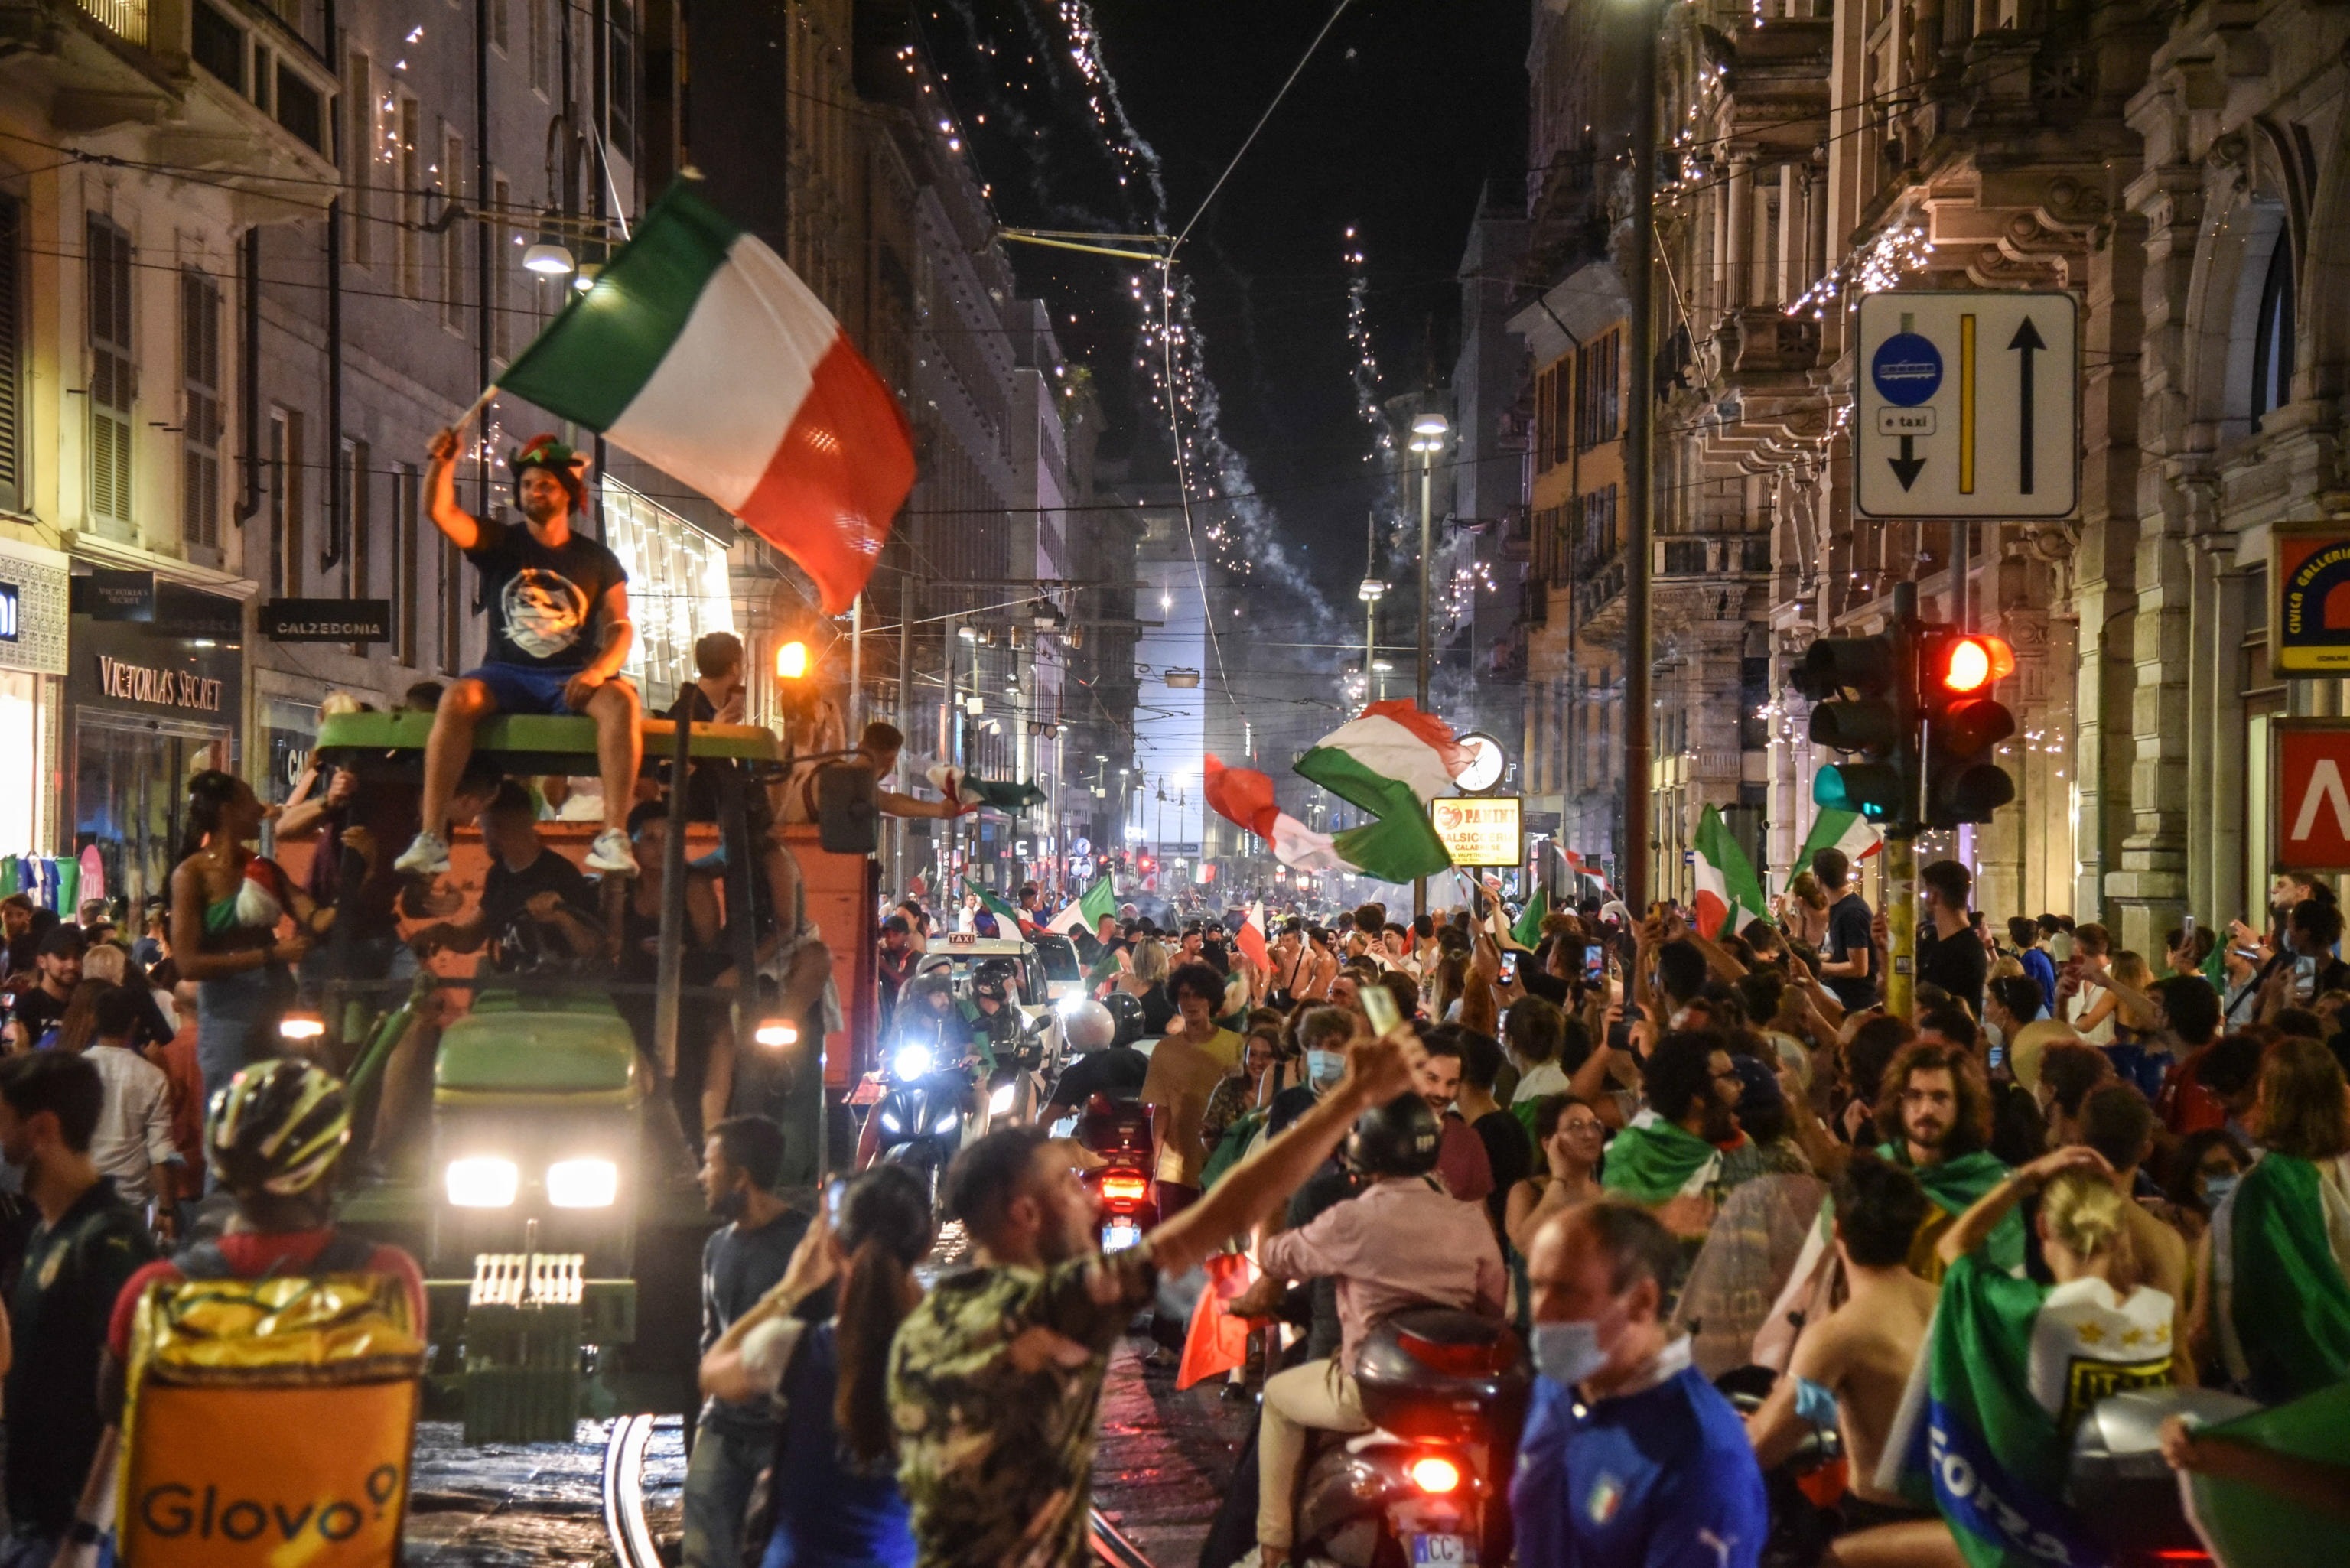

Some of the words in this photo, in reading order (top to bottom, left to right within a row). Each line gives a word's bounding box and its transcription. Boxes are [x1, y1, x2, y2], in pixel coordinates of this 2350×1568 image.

[1899, 416, 1927, 427] taxi
[2289, 591, 2303, 634] CIVICA
[277, 622, 380, 634] CALZEDONIA
[100, 655, 174, 705] VICTORIA'S
[177, 669, 222, 712] SECRET
[1464, 808, 1516, 823] PANINI
[949, 935, 973, 944] TAXI
[141, 1482, 363, 1543] Glovo
